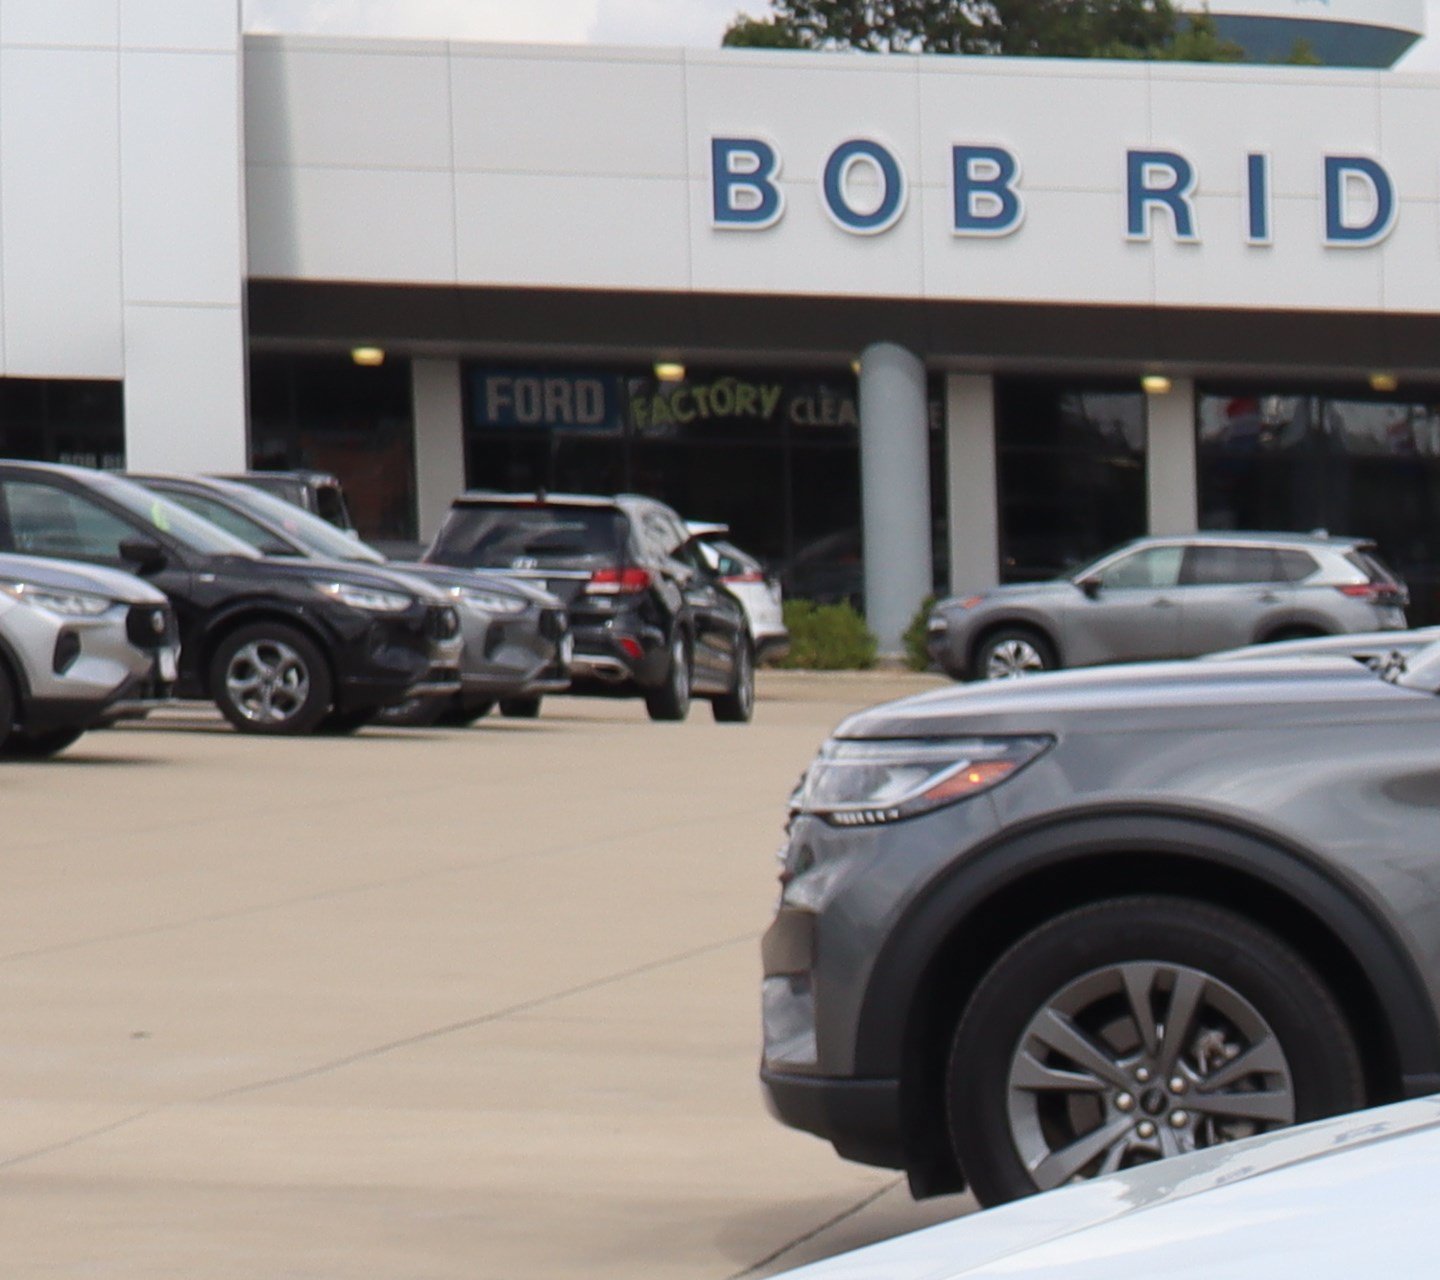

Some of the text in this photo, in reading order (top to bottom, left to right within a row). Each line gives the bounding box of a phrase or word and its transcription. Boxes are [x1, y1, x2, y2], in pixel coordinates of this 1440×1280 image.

[709, 134, 1023, 238] BOB
[485, 375, 605, 425] FORD
[631, 376, 782, 430] FACTORY
